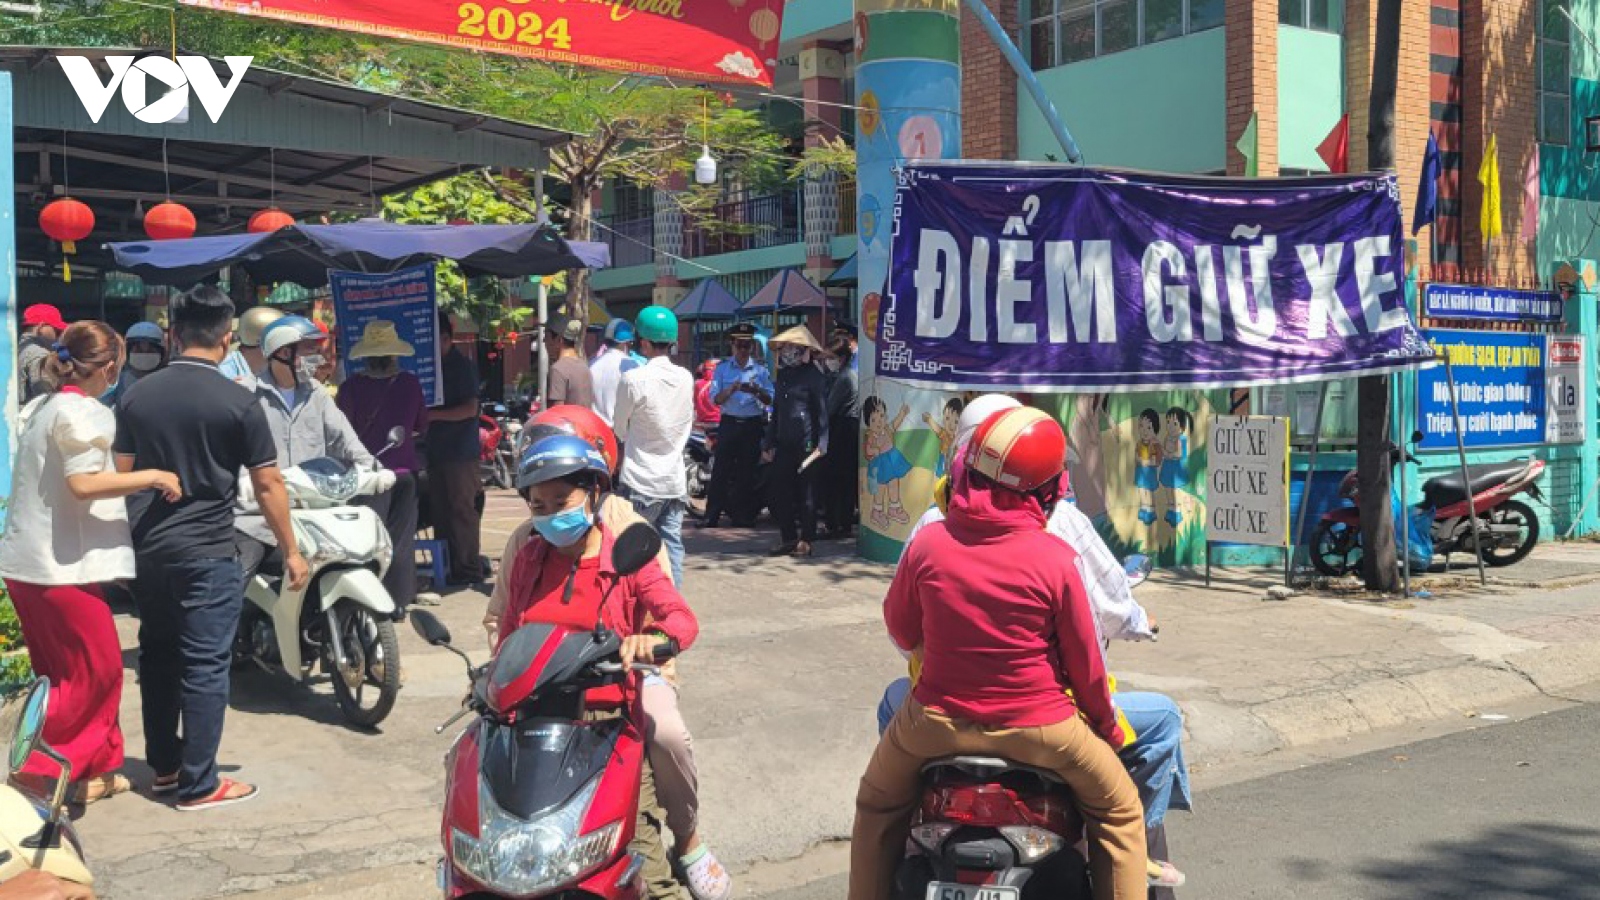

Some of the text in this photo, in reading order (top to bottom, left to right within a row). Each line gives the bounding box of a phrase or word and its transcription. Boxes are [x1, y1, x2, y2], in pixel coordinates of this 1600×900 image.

[458, 3, 571, 50] 2024
[914, 194, 1405, 343] ĐIỂM GIỮ XE
[1433, 381, 1451, 406] Mộ
[1215, 421, 1267, 456] GIỮ XE
[1213, 464, 1268, 496] GIỮ XE
[1213, 502, 1268, 534] GIỮ XE
